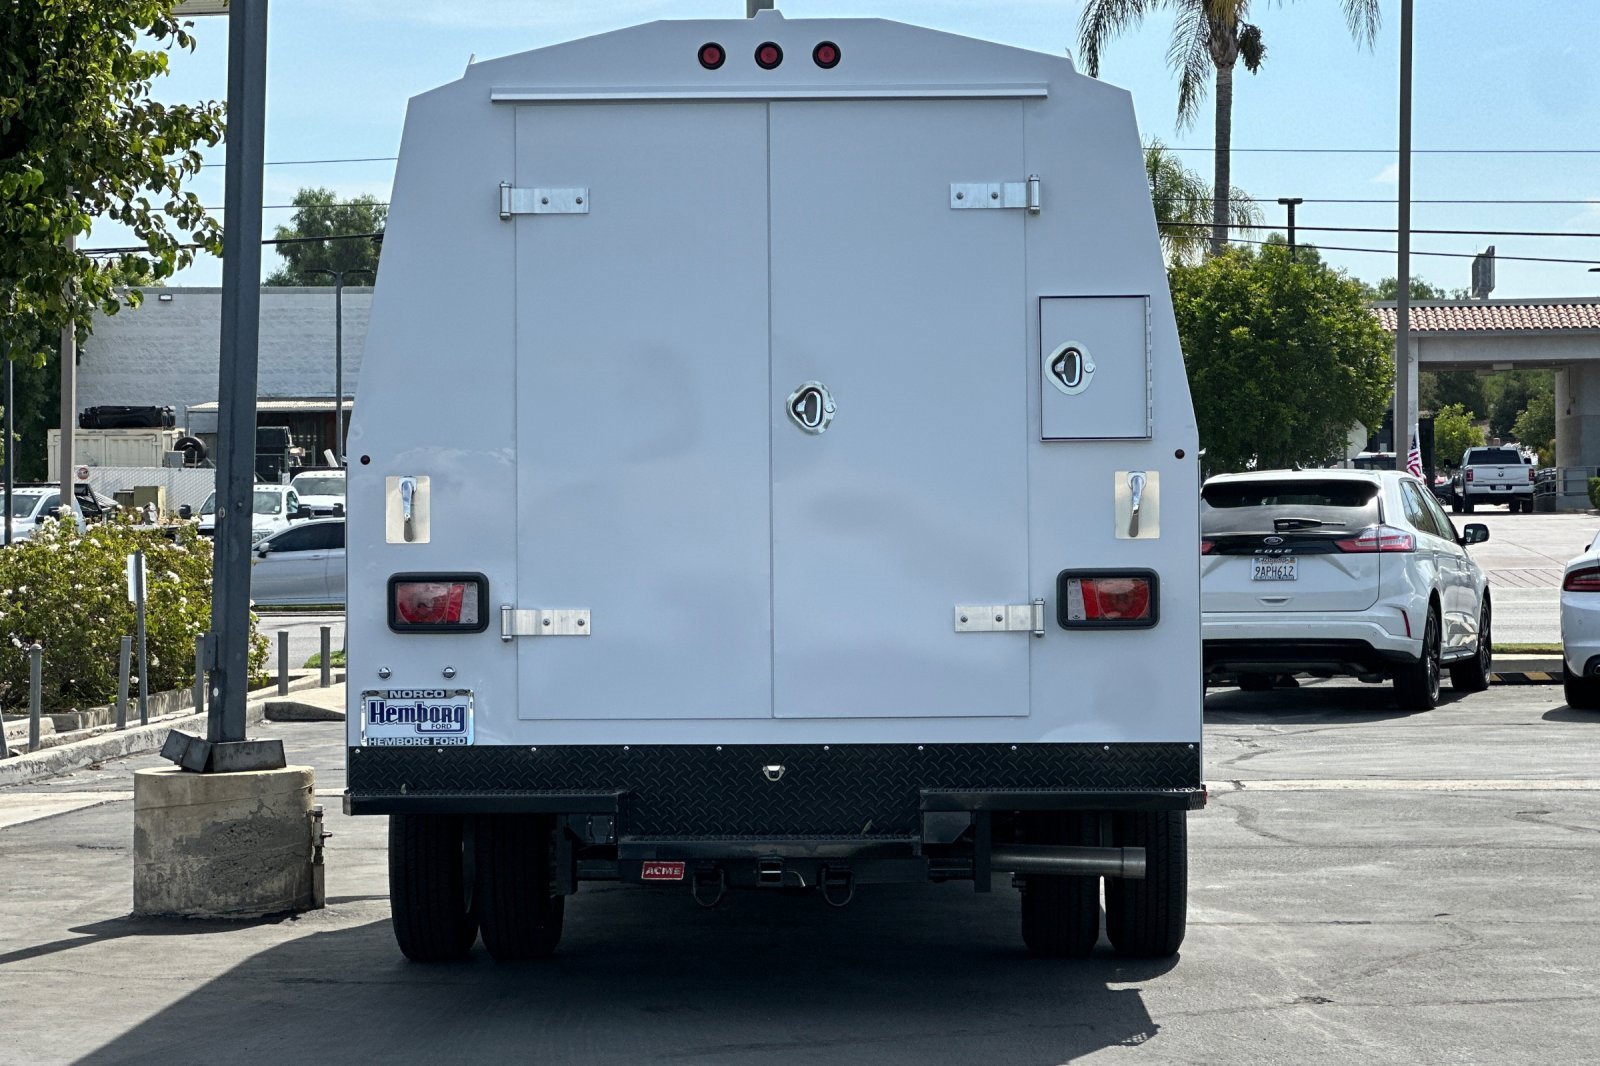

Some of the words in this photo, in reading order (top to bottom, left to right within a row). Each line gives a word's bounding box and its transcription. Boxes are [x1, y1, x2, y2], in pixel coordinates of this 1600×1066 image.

[1255, 566, 1294, 577] 9APH612
[389, 690, 441, 699] NORCO
[368, 700, 467, 734] Hemborg
[368, 738, 430, 746] HEMBORG
[433, 738, 466, 746] FORD
[645, 867, 681, 875] ACME
